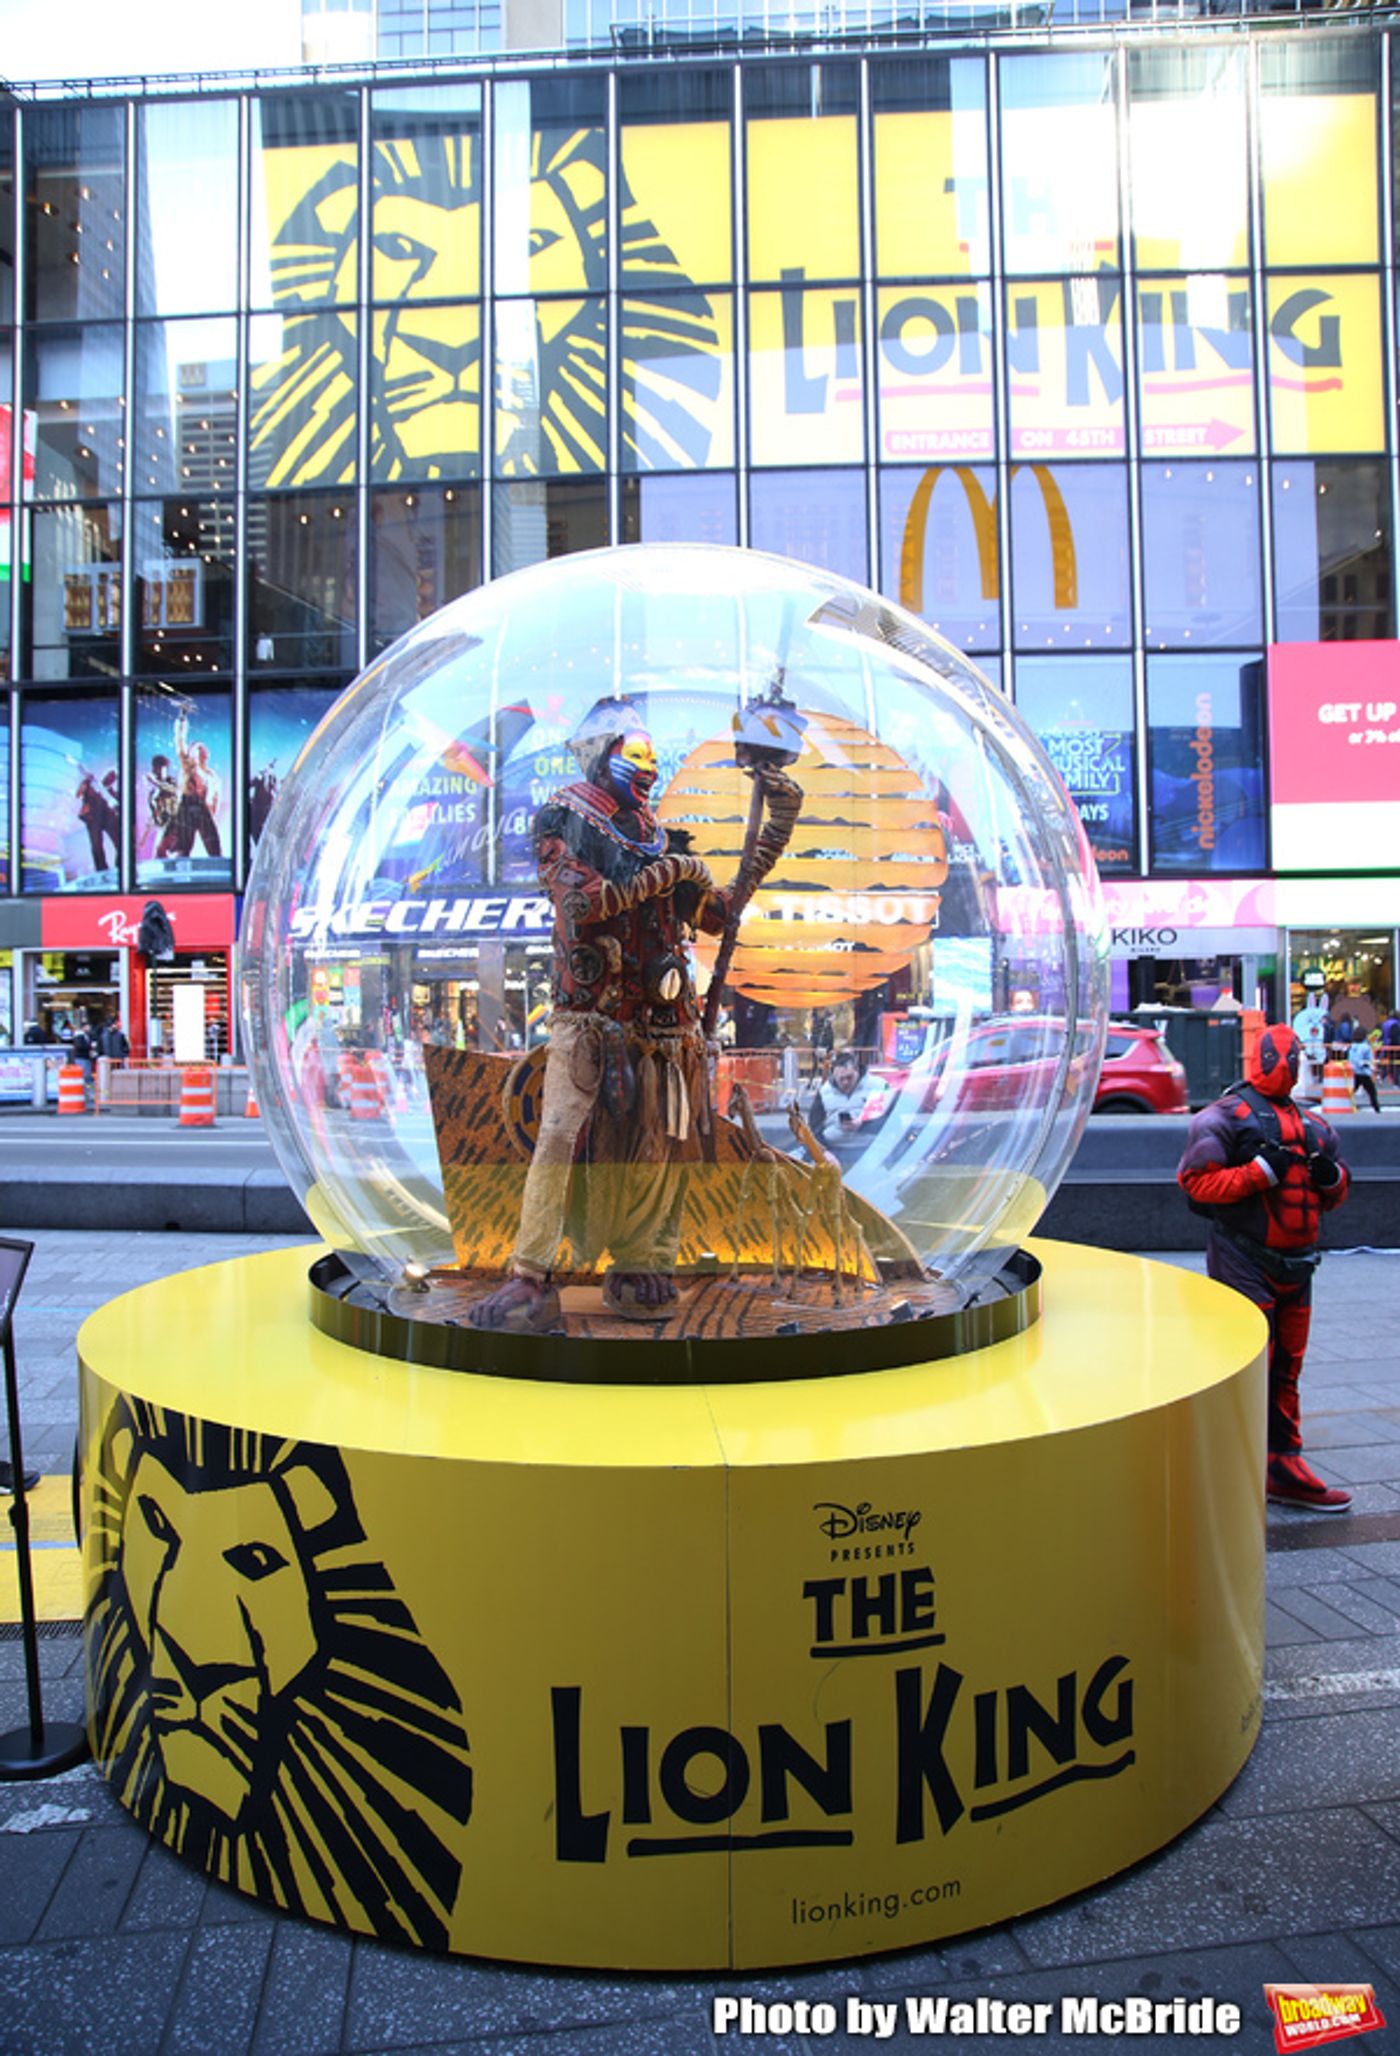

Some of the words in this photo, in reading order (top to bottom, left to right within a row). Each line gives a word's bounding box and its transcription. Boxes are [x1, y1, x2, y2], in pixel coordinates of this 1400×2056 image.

[780, 267, 1041, 414] LION
[1062, 261, 1343, 406] KING
[891, 431, 990, 450] ENTRANCE
[1020, 430, 1053, 448] ON
[1066, 428, 1115, 447] 45TH
[1144, 427, 1208, 445] STREET
[1318, 703, 1362, 724] GET
[1365, 702, 1397, 722] UP
[1048, 739, 1105, 756] MOST
[1189, 692, 1215, 849] nickelodeon
[772, 896, 933, 924] TISSOT
[1111, 927, 1178, 946] KIKO
[813, 1502, 922, 1540] Disney
[830, 1542, 915, 1562] PRESENTS
[803, 1566, 936, 1643] THE
[550, 1686, 853, 1864] LION
[895, 1654, 1135, 1846] KING
[791, 1880, 961, 1925] lionking.com
